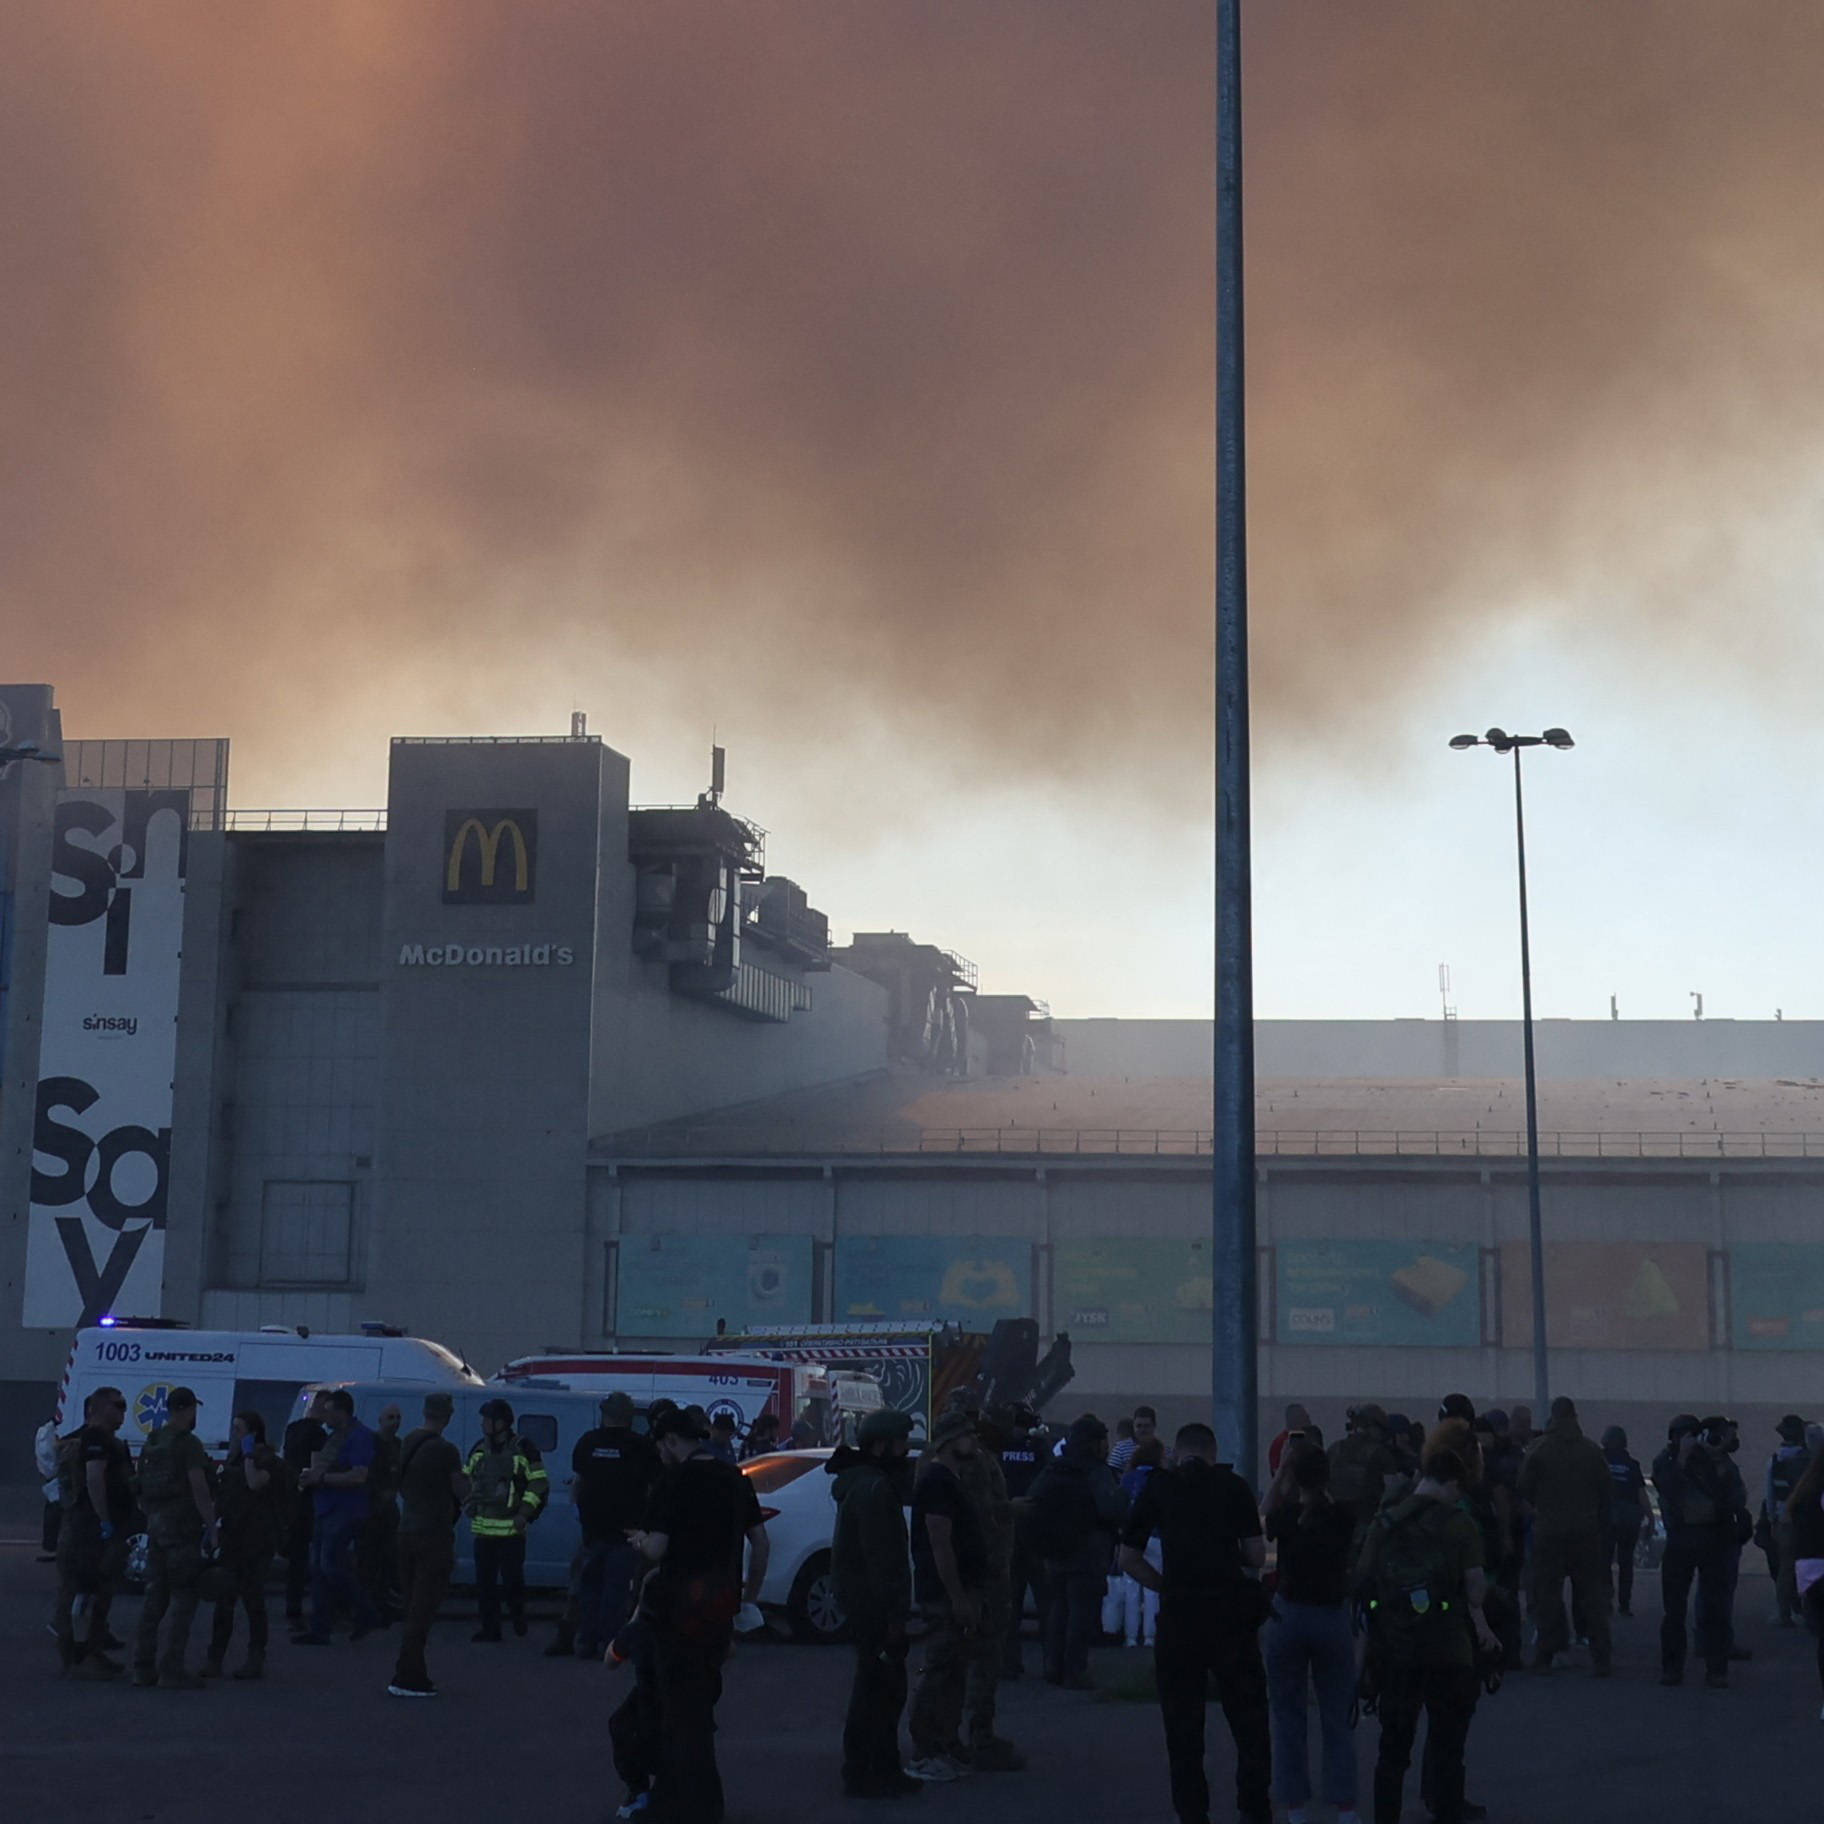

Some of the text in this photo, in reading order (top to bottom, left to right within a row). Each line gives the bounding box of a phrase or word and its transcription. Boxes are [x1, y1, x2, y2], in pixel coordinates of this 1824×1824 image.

[399, 942, 575, 968] McDonald's
[95, 1341, 236, 1364] 1003 UNITED24
[1001, 1450, 1036, 1463] PRESS
